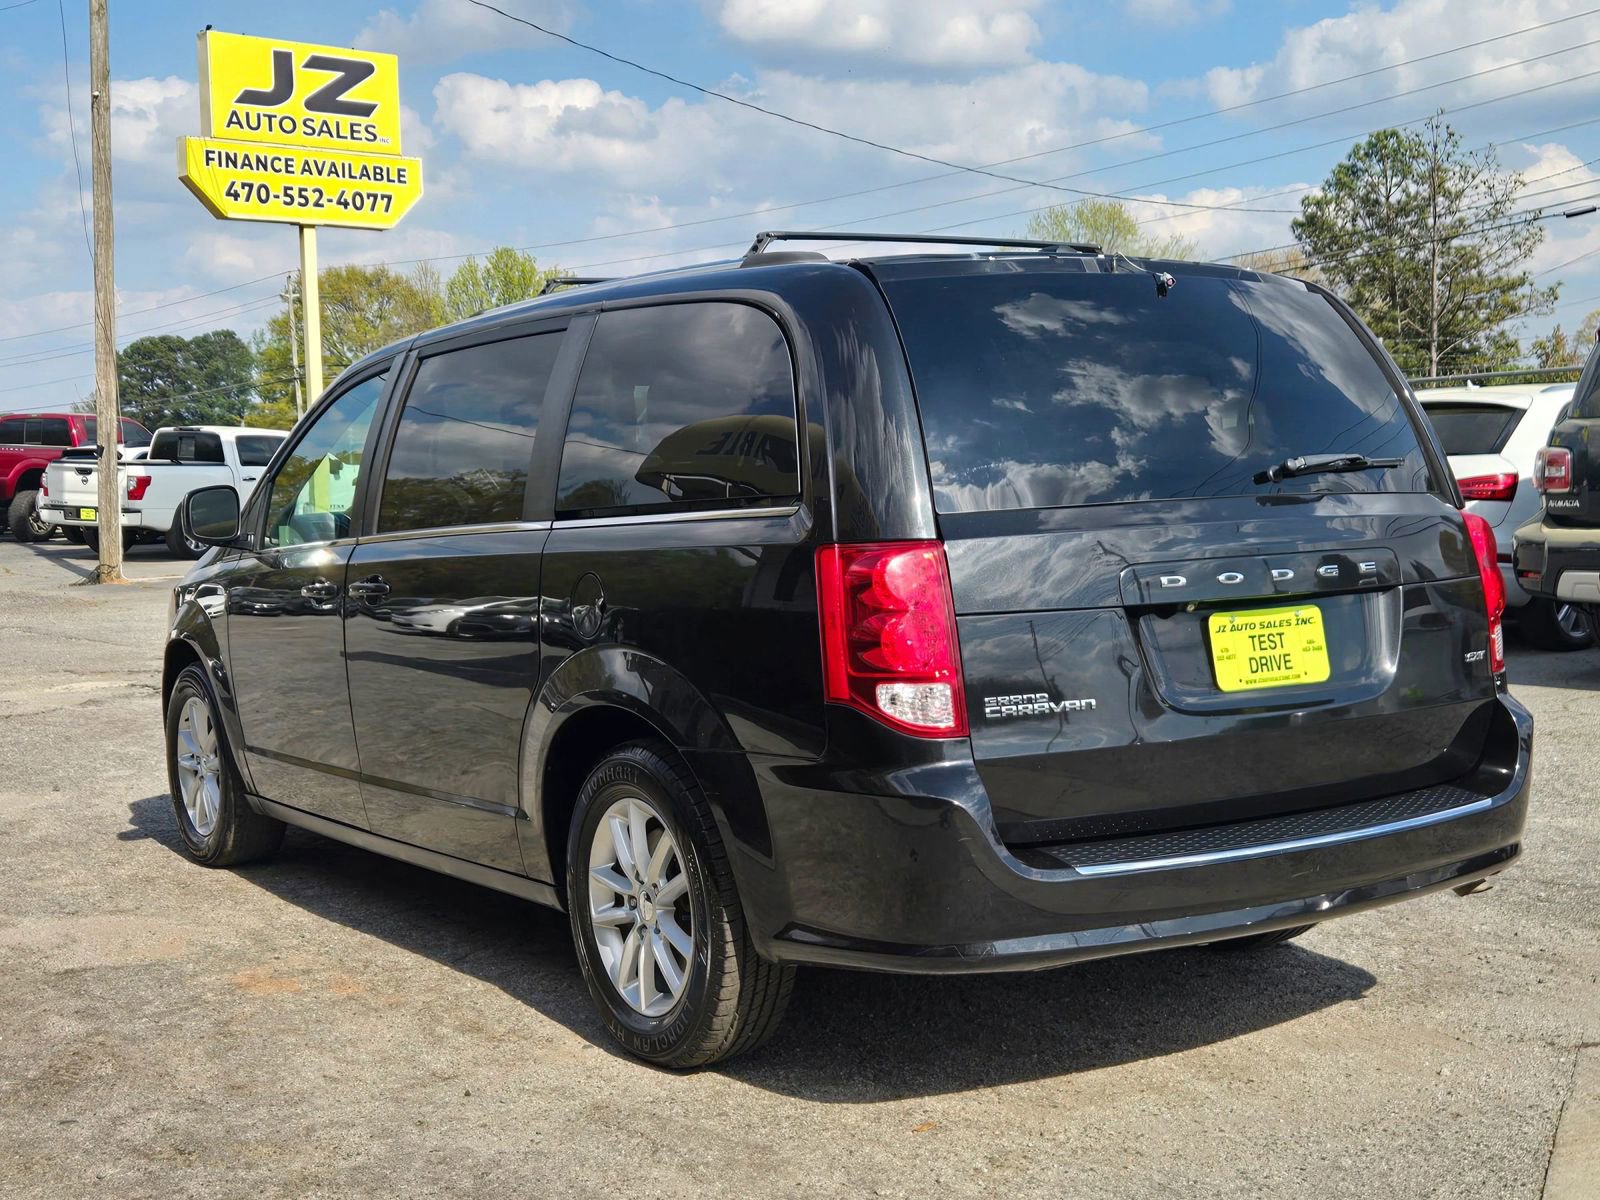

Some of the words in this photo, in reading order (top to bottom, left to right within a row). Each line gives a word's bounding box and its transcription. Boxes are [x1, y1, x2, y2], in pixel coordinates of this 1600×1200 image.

[234, 49, 379, 118] JZ
[225, 110, 298, 134] AUTO
[302, 117, 378, 143] SALES
[205, 149, 295, 174] FINANCE
[300, 159, 407, 184] AVAILABLE
[225, 181, 393, 213] 470-552-4077
[1160, 561, 1377, 588] DODGE
[1215, 624, 1227, 633] JZ
[1229, 622, 1257, 632] AUTO
[1259, 619, 1292, 630] SALES
[1248, 632, 1285, 652] TEST
[1248, 653, 1293, 674] DRIVE
[984, 692, 1049, 707] GRAND
[984, 698, 1097, 718] CARAVAN
